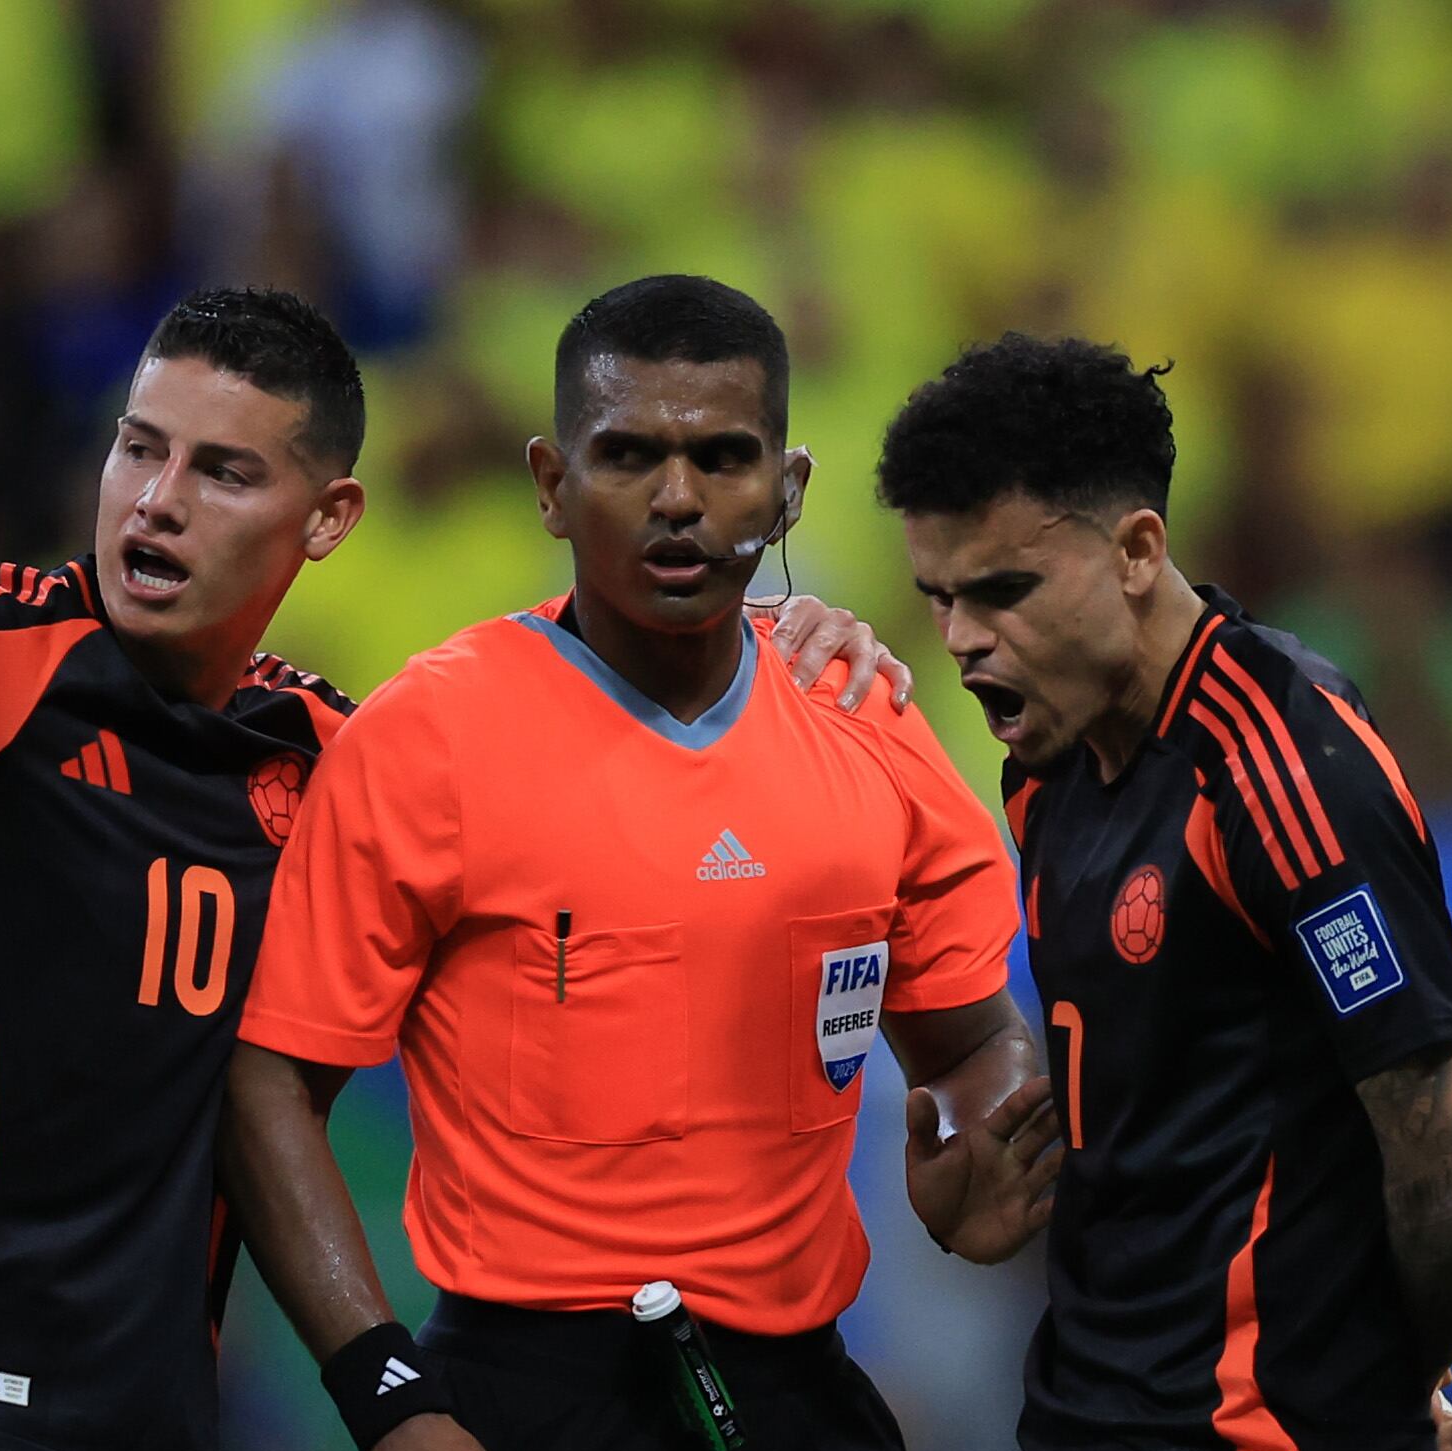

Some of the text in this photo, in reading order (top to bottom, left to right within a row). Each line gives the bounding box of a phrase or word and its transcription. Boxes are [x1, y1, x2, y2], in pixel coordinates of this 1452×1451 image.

[696, 860, 766, 881] adidas
[138, 857, 235, 1016] 10
[1314, 910, 1362, 944] FOOTBALL
[1321, 924, 1369, 961] UNITES
[826, 954, 880, 996] FIFA
[1330, 941, 1379, 978] the World
[1353, 972, 1372, 986] FIFA
[822, 1009, 875, 1038] REFEREE
[1052, 1000, 1083, 1149] 7
